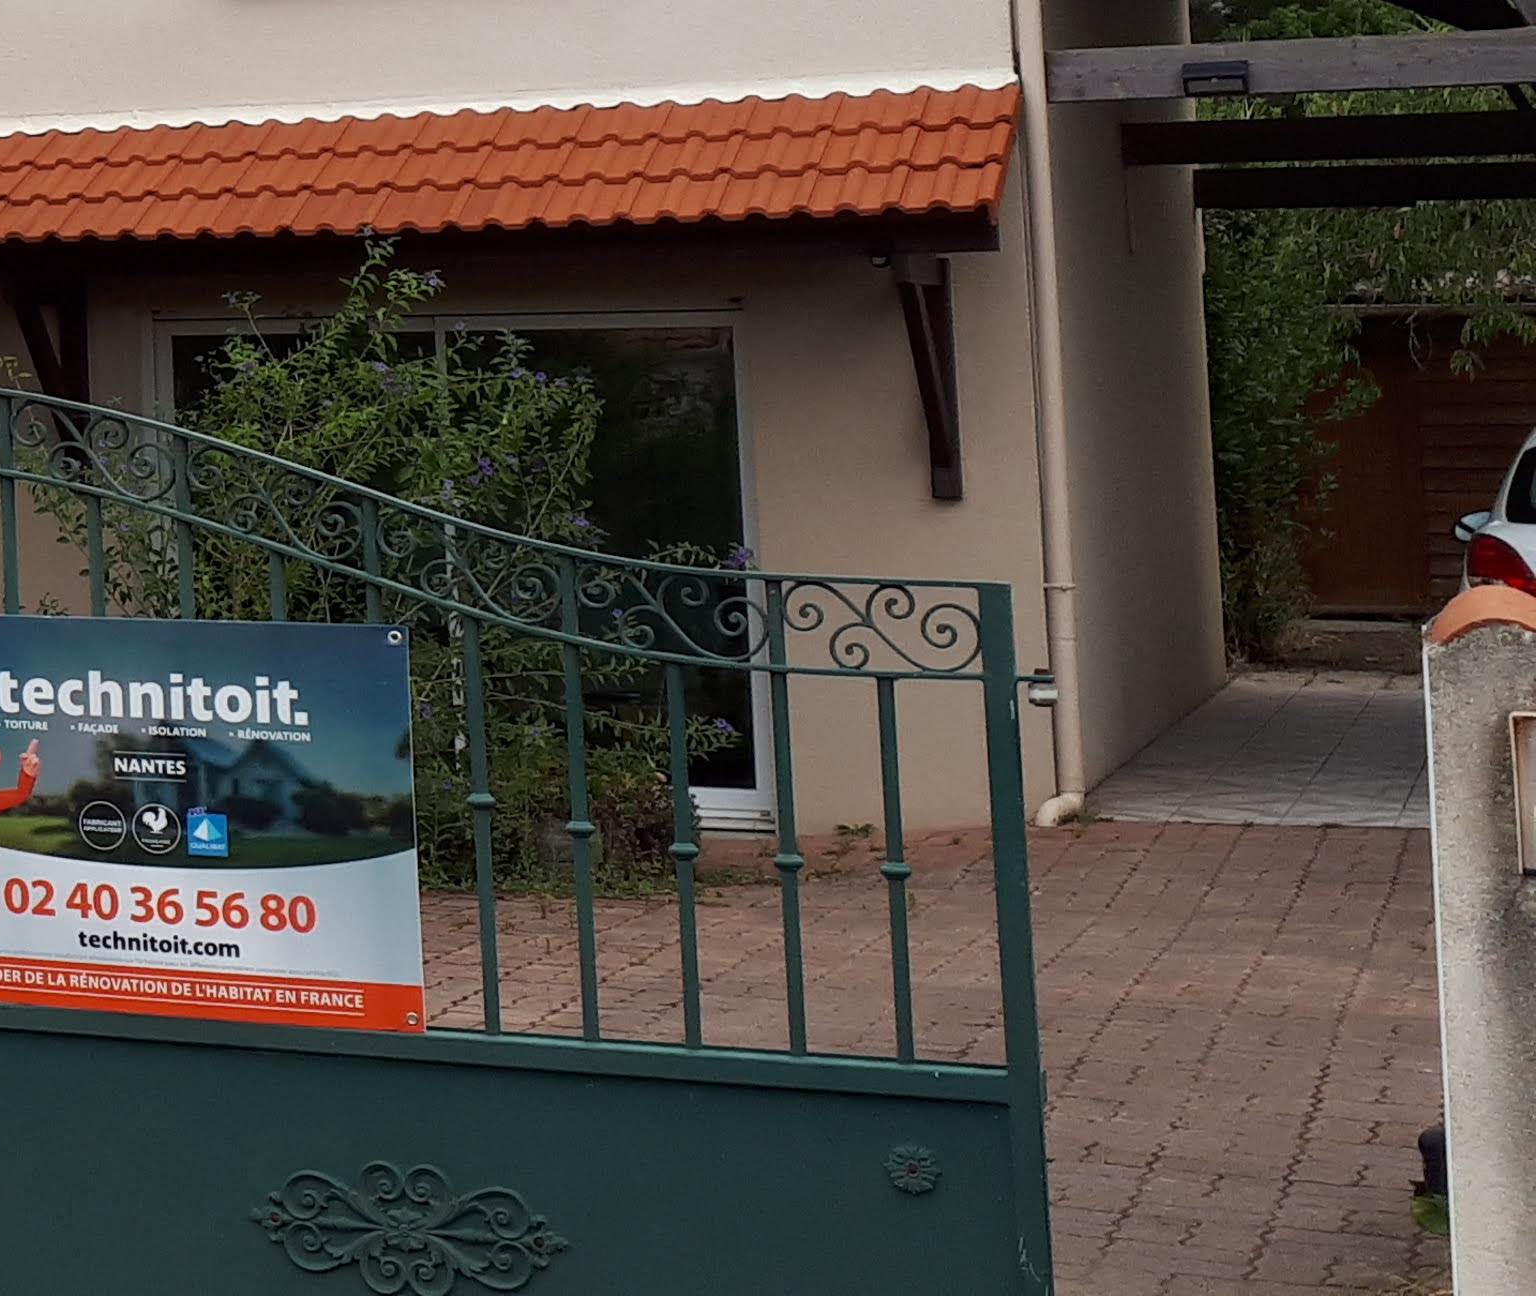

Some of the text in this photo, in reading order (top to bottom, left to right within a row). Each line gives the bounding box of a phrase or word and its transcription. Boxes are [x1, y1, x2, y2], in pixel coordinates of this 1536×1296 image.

[4, 720, 311, 742] TOITURE FAÇADE ISOLATION RÉNOVATION
[114, 757, 186, 775] NANTES
[4, 877, 316, 933] 02 40 36 56 80
[78, 930, 240, 958] technitoit.com
[25, 971, 44, 985] DE
[48, 973, 66, 987] LA
[70, 972, 168, 995] RÉNOVATION
[171, 982, 192, 996] DE
[196, 983, 272, 1003] L'HABITAT
[275, 989, 297, 1004] EN
[300, 991, 364, 1009] FRANCE
